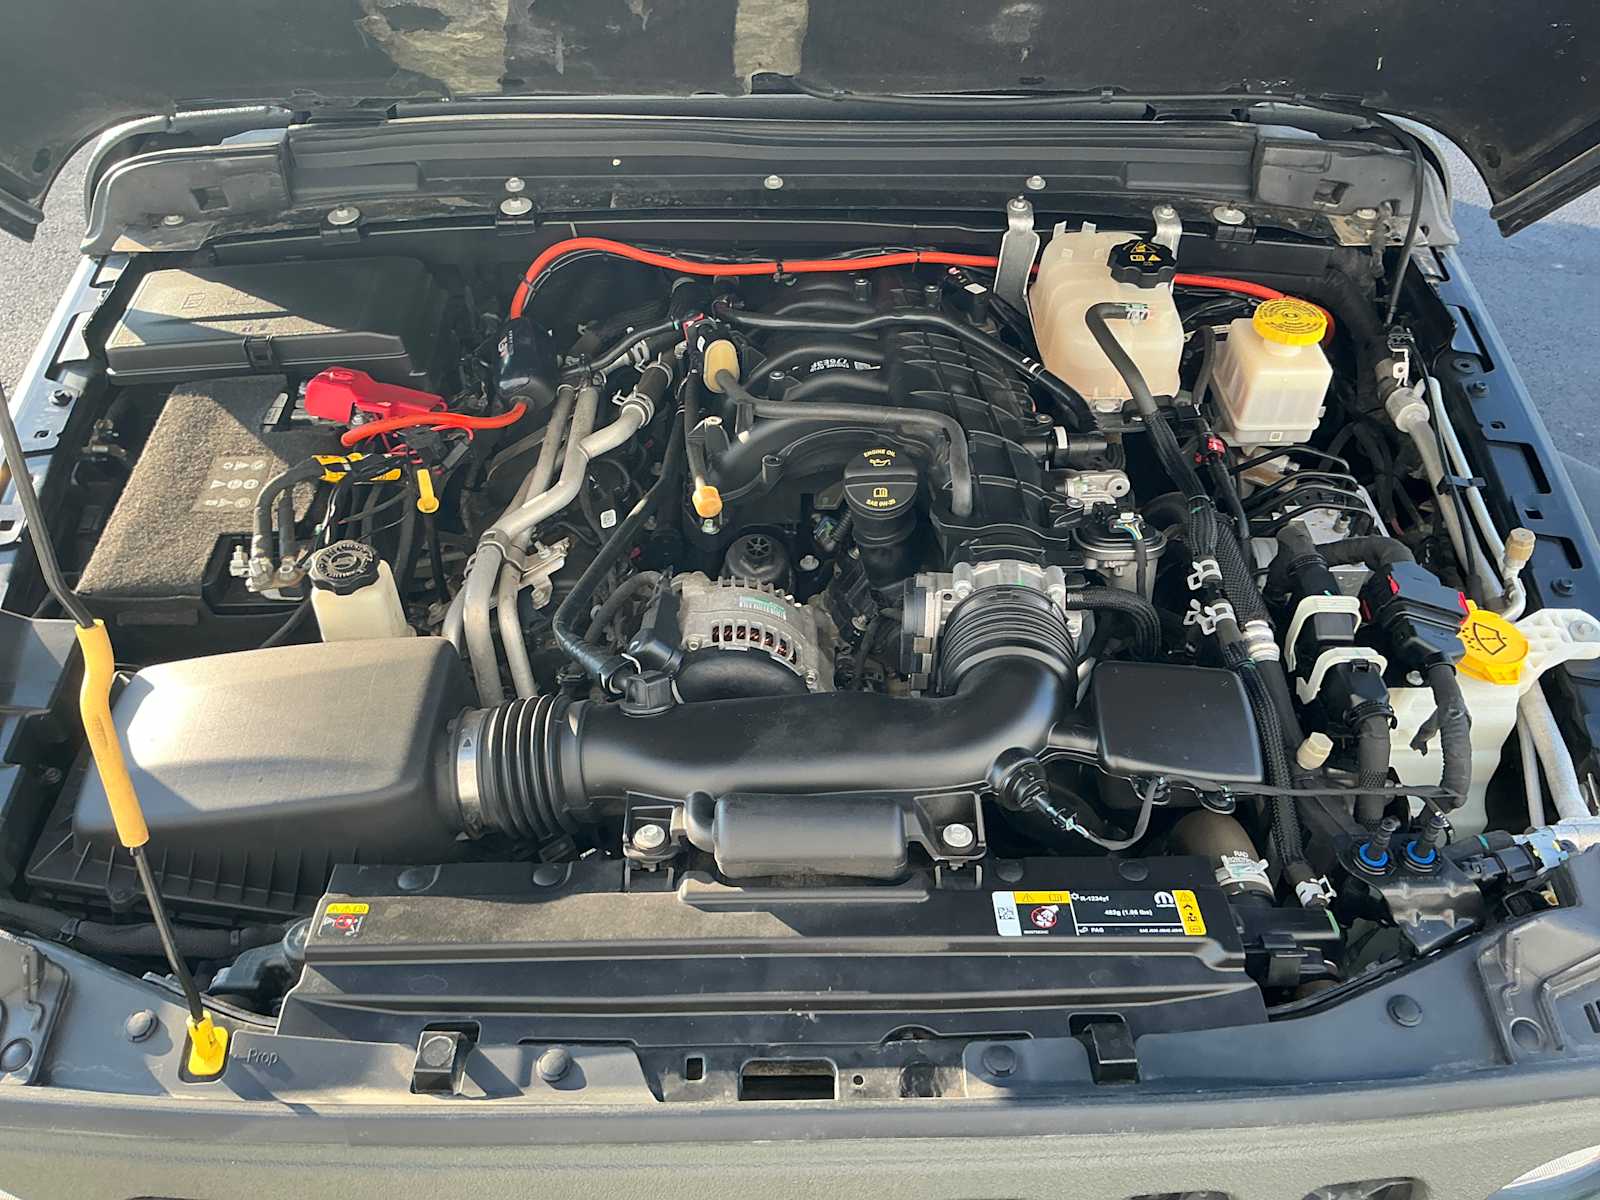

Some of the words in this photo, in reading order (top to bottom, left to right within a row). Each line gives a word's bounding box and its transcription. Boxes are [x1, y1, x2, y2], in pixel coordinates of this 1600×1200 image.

[864, 449, 886, 457] ENGINE
[886, 449, 897, 458] OIL
[865, 499, 878, 507] SAE
[246, 1047, 278, 1067] Prop
